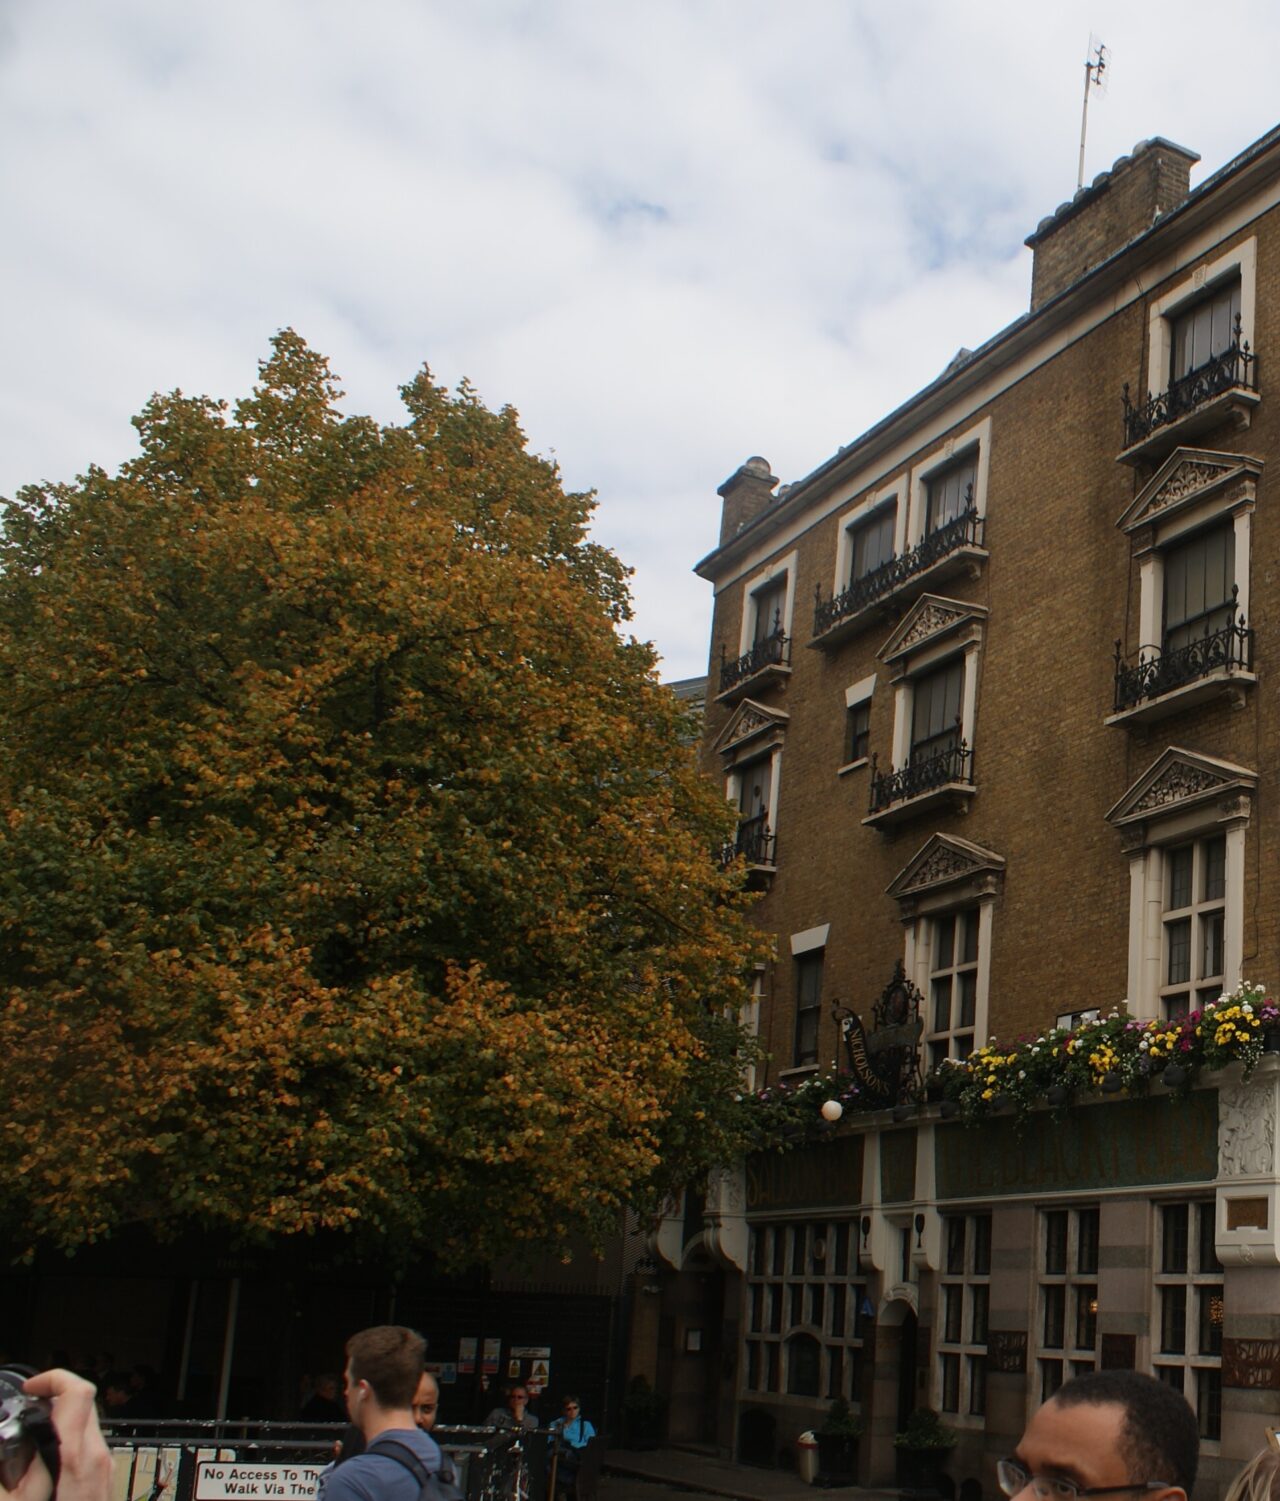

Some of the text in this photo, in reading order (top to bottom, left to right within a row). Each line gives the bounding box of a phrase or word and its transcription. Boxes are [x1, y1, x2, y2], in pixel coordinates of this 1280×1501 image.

[204, 1468, 319, 1481] No Access To Th
[225, 1483, 315, 1495] Walk Via The
